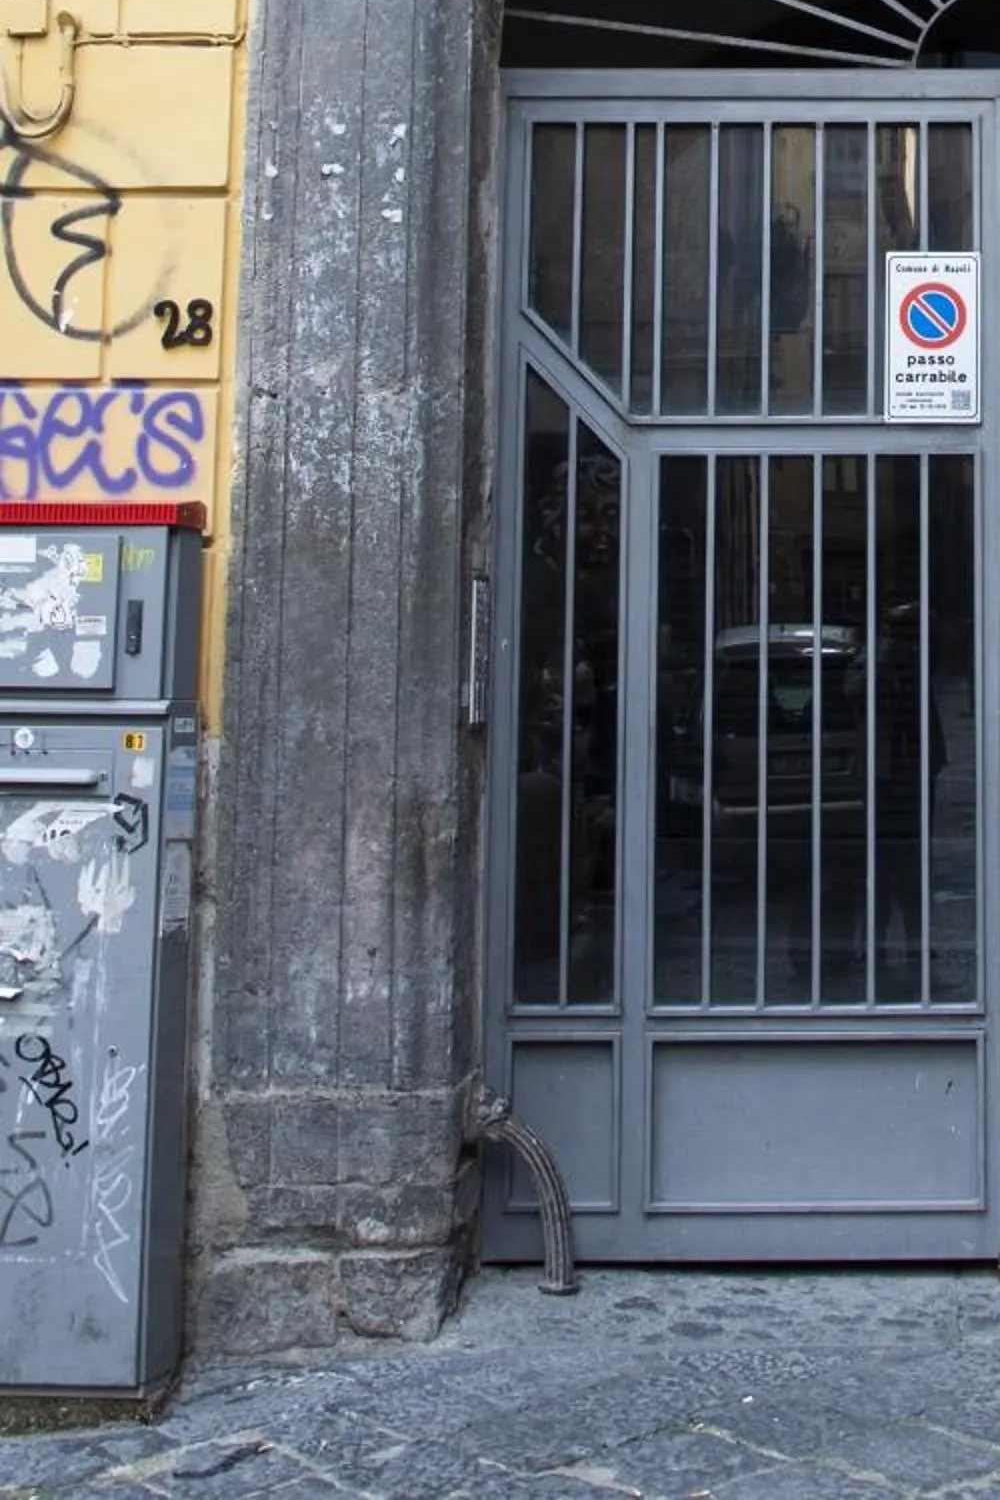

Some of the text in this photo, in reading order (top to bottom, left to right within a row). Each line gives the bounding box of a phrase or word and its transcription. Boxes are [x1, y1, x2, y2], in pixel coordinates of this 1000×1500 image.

[153, 298, 213, 349] 28
[907, 355, 955, 368] passo
[895, 370, 967, 383] carrabile
